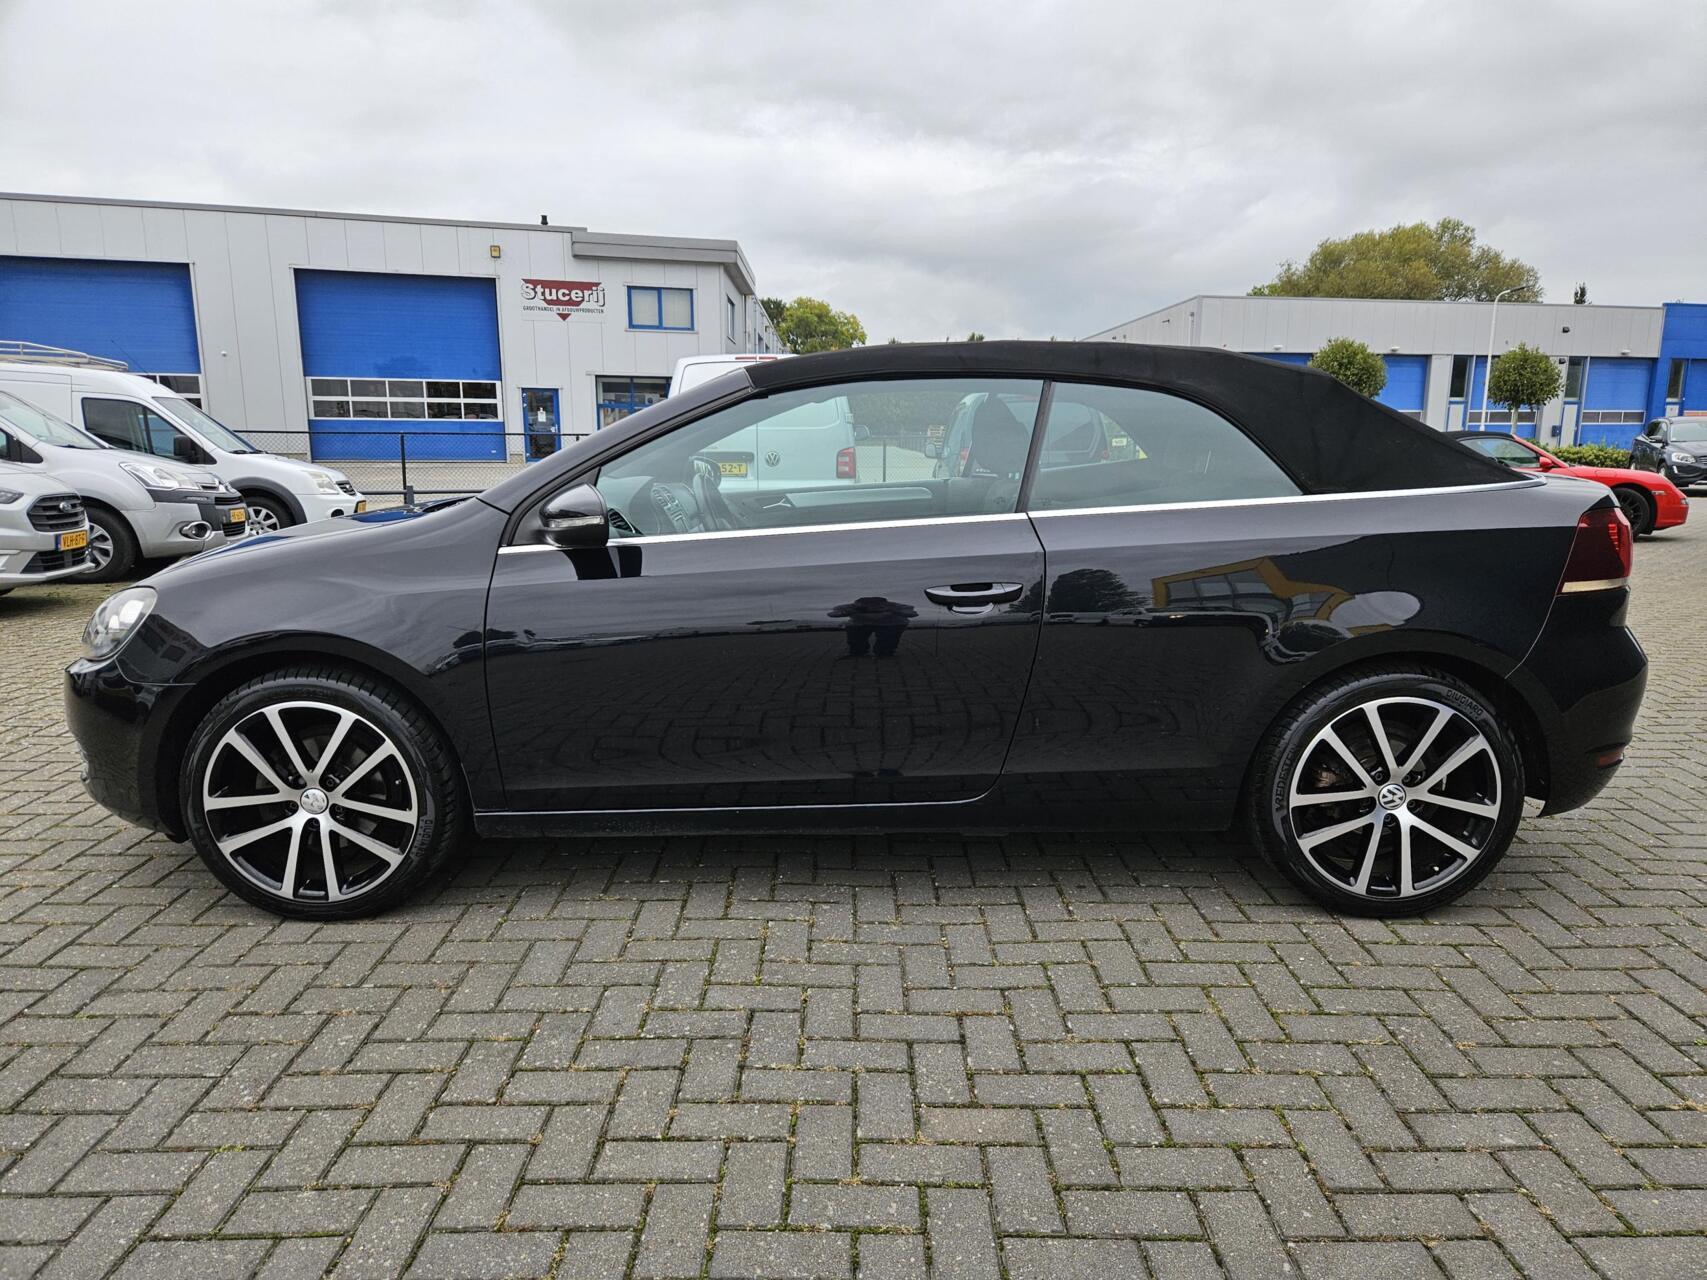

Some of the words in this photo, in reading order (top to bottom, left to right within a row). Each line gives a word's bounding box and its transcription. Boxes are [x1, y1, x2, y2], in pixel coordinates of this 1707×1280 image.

[521, 282, 606, 307] Stucerij
[523, 305, 555, 313] GROOTHANDEL
[721, 463, 743, 473] 52-T
